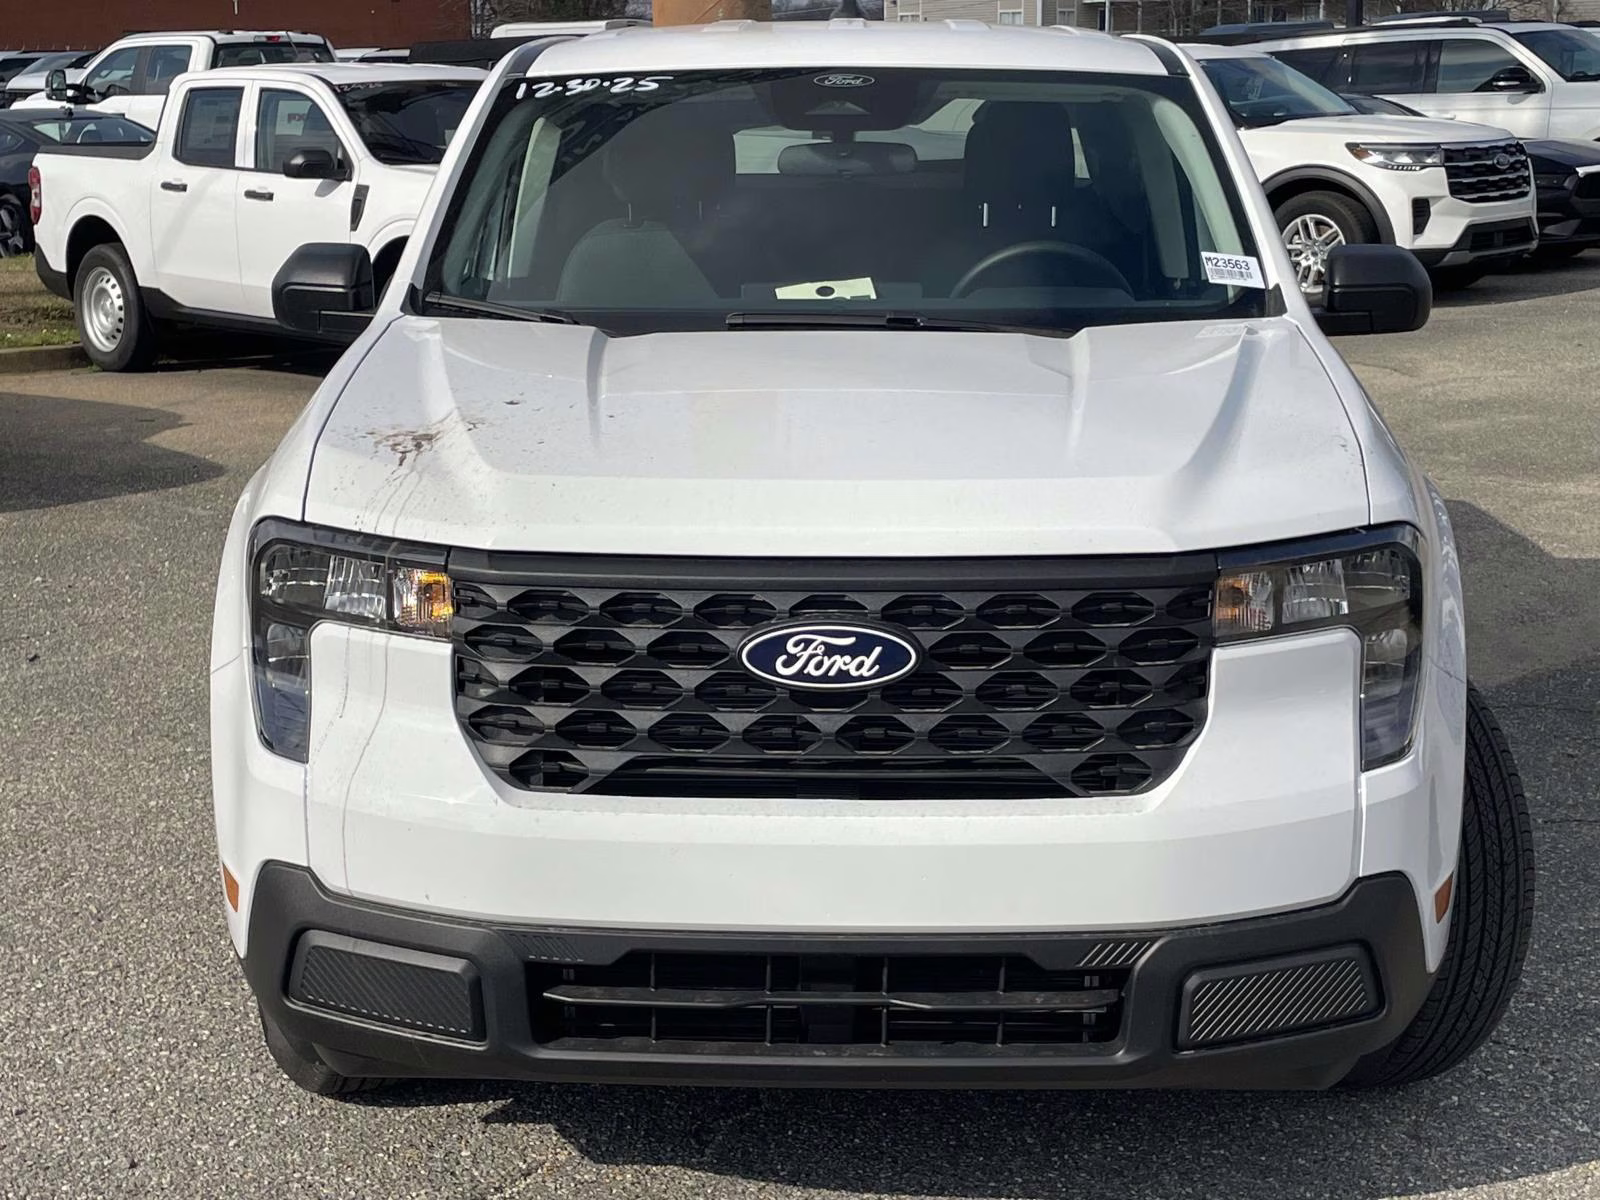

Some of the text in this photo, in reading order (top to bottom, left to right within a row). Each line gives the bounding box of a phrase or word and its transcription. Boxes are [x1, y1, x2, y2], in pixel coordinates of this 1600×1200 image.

[824, 75, 865, 85] Ford
[1205, 256, 1250, 271] M23563
[775, 634, 883, 677] Ford
